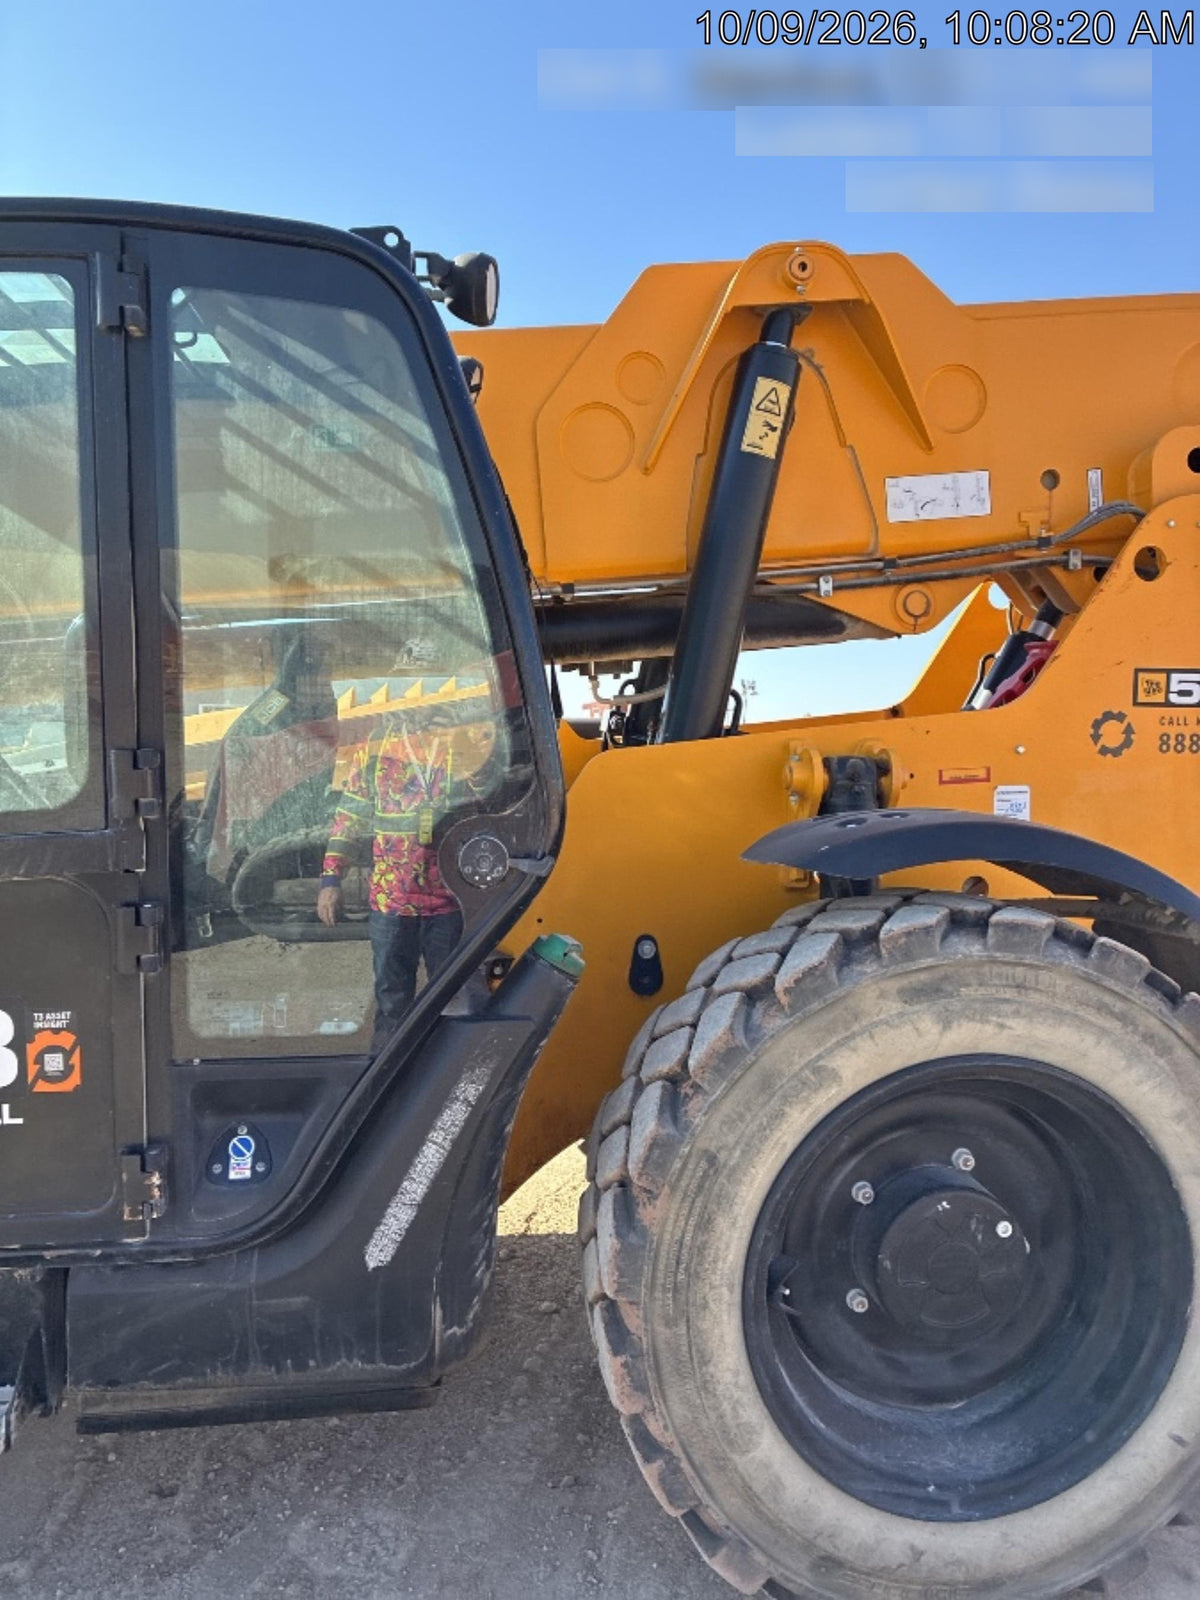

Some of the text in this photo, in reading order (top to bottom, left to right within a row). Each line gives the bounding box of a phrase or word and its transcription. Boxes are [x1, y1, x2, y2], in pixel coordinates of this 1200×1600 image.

[1159, 716, 1189, 727] CALL
[1158, 733, 1200, 754] 888
[0, 1103, 24, 1125] L
